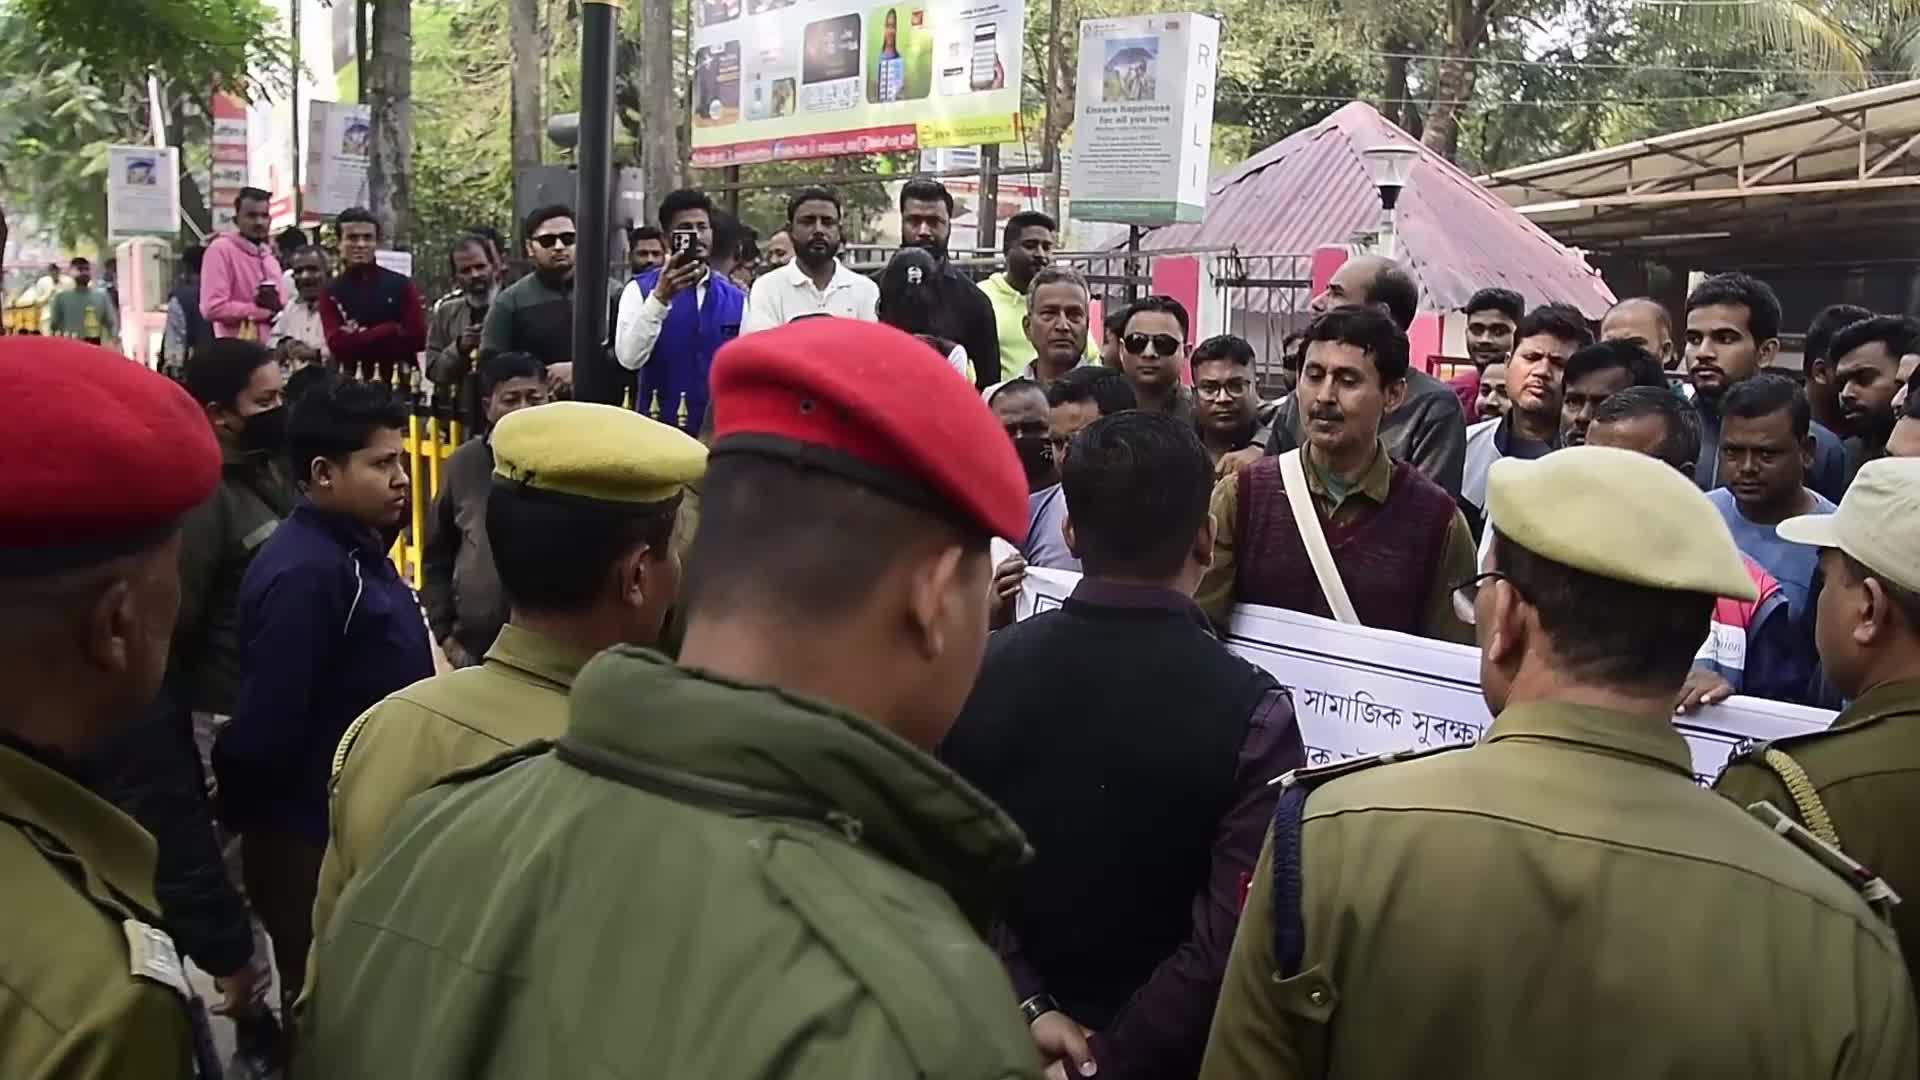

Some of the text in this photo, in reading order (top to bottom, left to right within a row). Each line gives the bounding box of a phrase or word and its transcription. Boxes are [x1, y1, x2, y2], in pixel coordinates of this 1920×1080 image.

[1086, 104, 1171, 116] Ensure happiness
[1193, 43, 1210, 188] RPLI
[1304, 689, 1403, 730] সামাজিক
